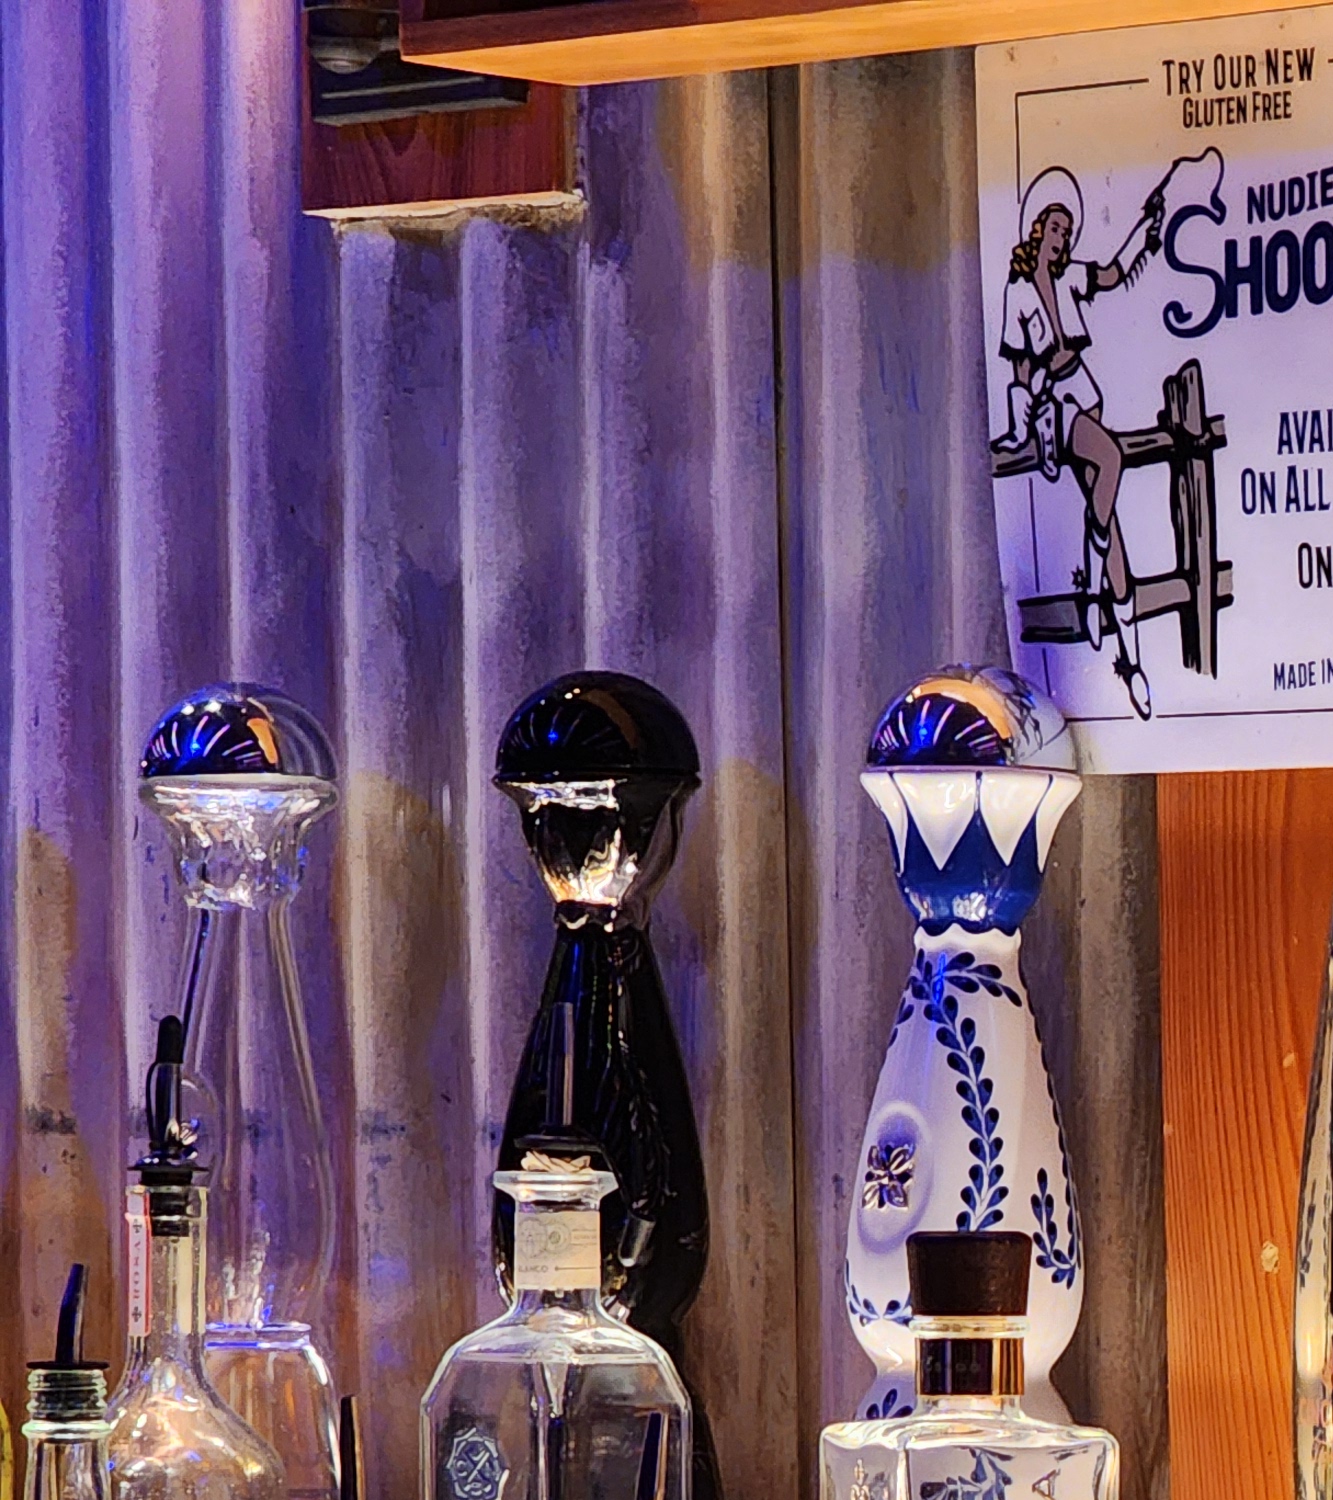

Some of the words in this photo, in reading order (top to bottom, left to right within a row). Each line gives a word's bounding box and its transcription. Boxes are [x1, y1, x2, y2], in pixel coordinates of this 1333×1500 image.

[1162, 59, 1205, 96] TRY
[1214, 54, 1257, 90] OUR
[1265, 47, 1316, 86] NEW
[1182, 94, 1248, 129] GLUTEN
[1252, 90, 1293, 124] FREE
[1240, 467, 1276, 515] ON
[1285, 465, 1331, 513] ALL
[1273, 661, 1317, 691] MADE
